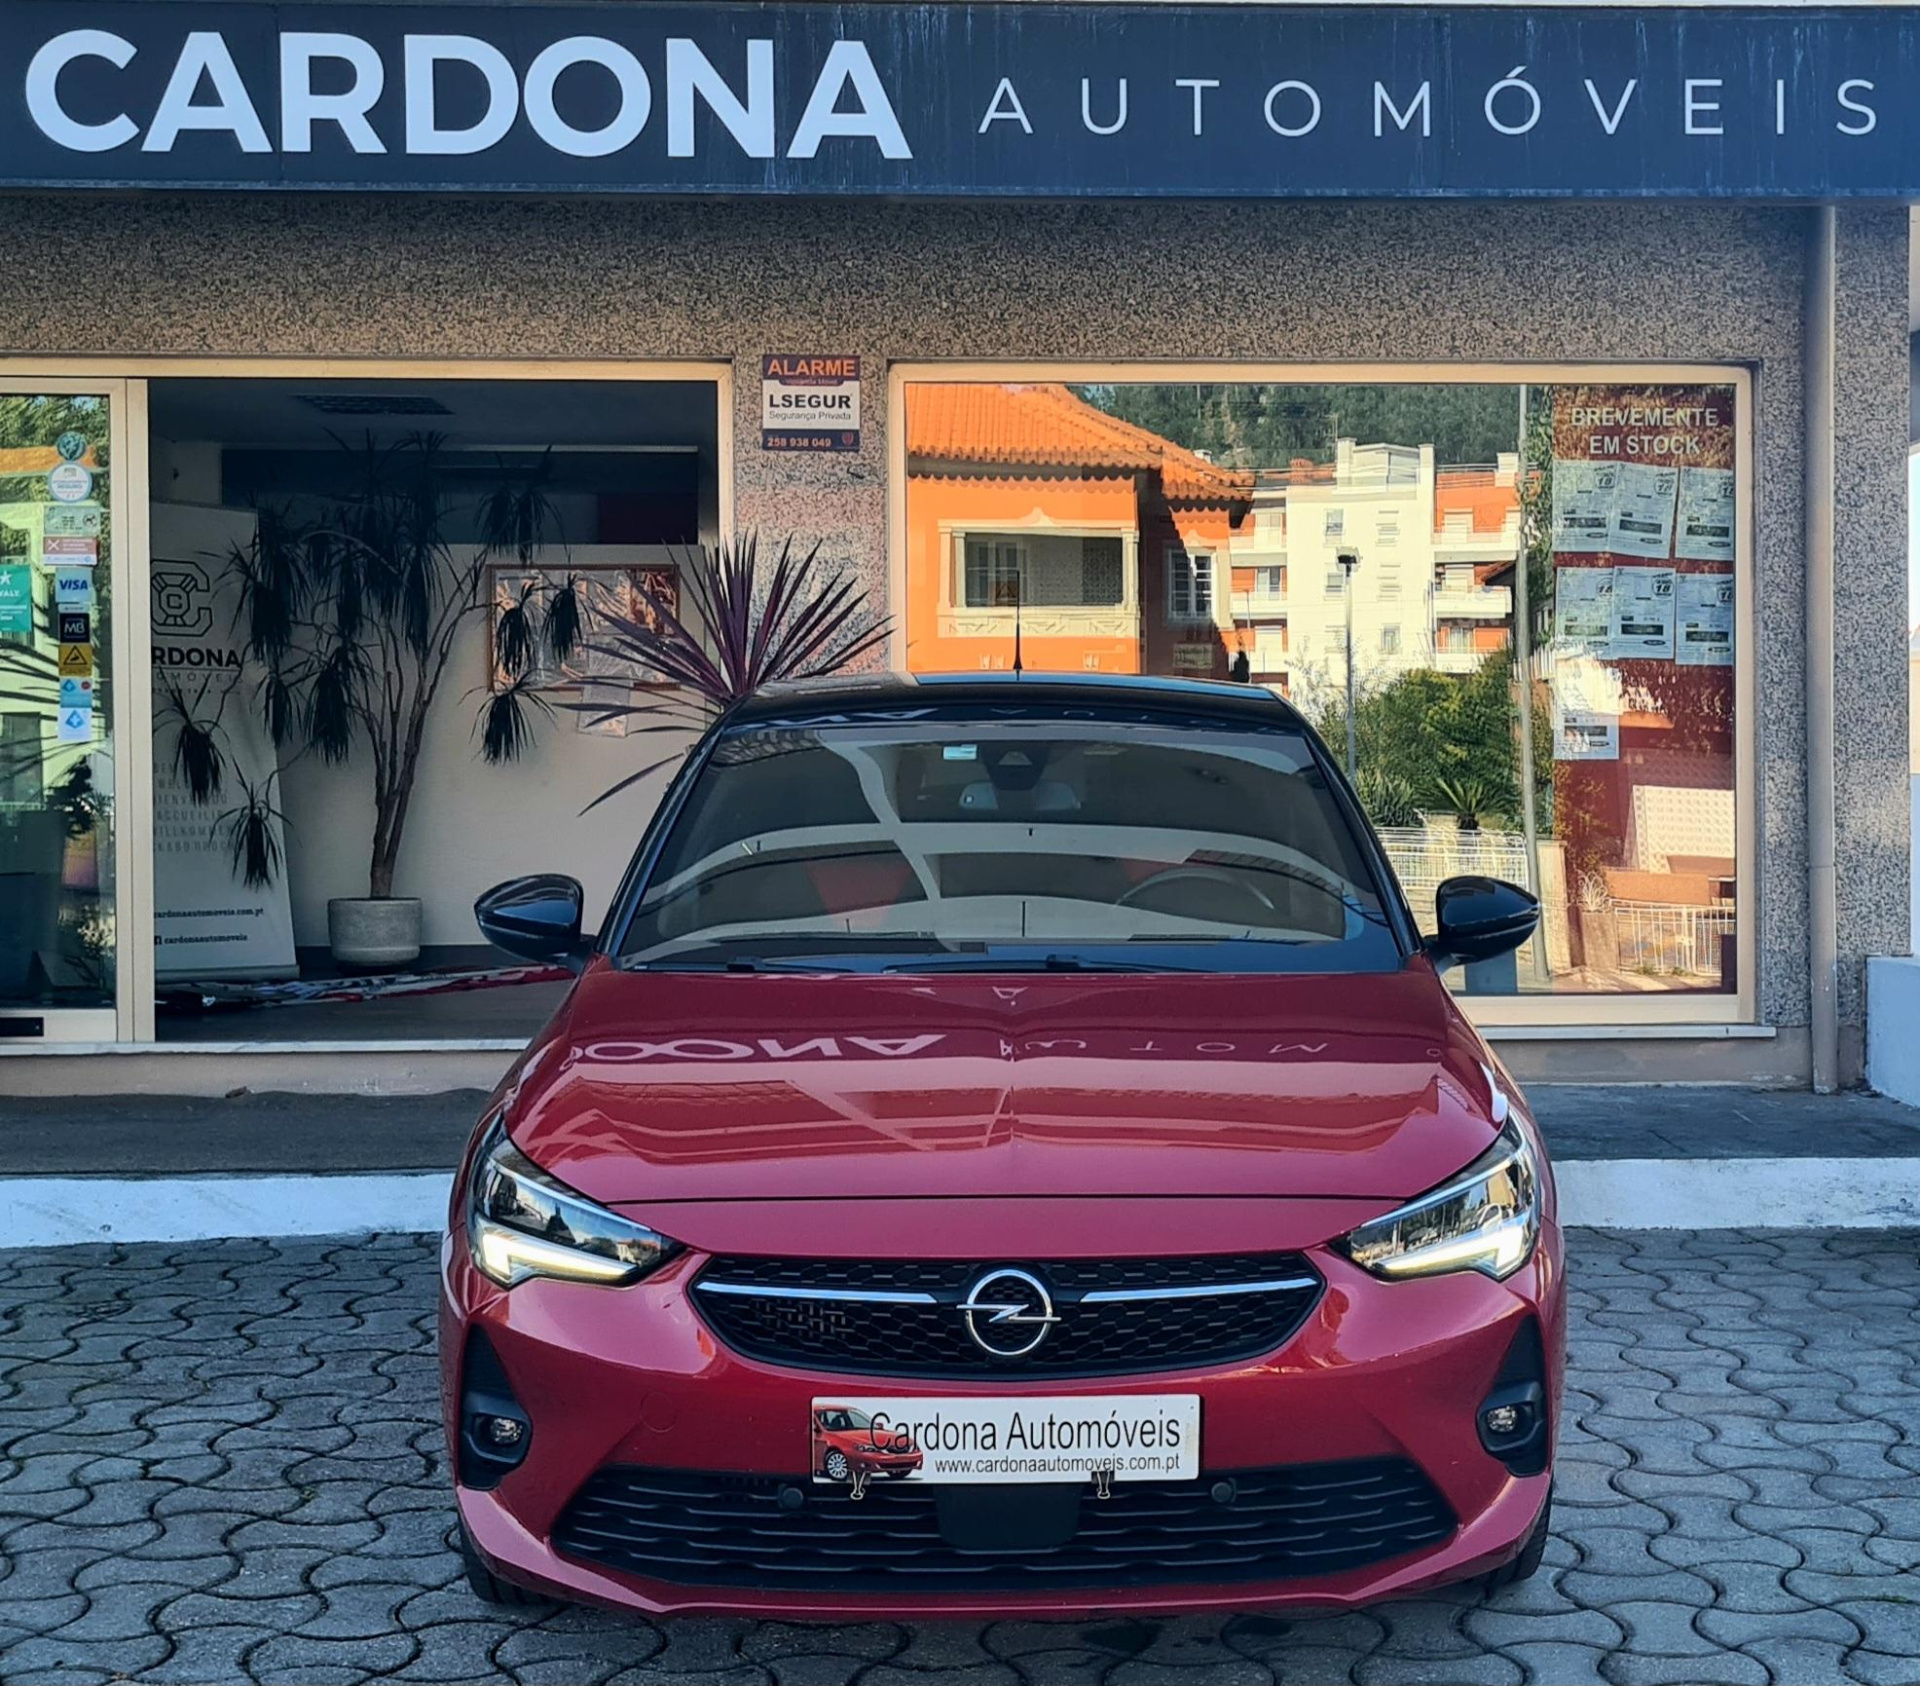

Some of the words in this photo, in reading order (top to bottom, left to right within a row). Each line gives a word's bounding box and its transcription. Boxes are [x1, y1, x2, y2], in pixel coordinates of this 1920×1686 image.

[25, 29, 914, 160] CARDONA
[977, 65, 1879, 138] AUTOMÓVEIS
[767, 359, 856, 376] ALARME
[769, 394, 851, 409] LSEGUR
[769, 410, 816, 421] Segurança
[818, 410, 851, 421] Privada
[1571, 407, 1719, 427] BREVEMENTE
[1589, 435, 1620, 454] EM
[1626, 435, 1700, 455] STOCK
[59, 579, 88, 590] VISA
[1656, 584, 1671, 593] 18
[64, 620, 85, 633] MB
[870, 1412, 996, 1450] Cardona
[1006, 1409, 1181, 1451] Automóveis
[935, 1453, 1180, 1474] www.cardonaautomoveis.com.pt
